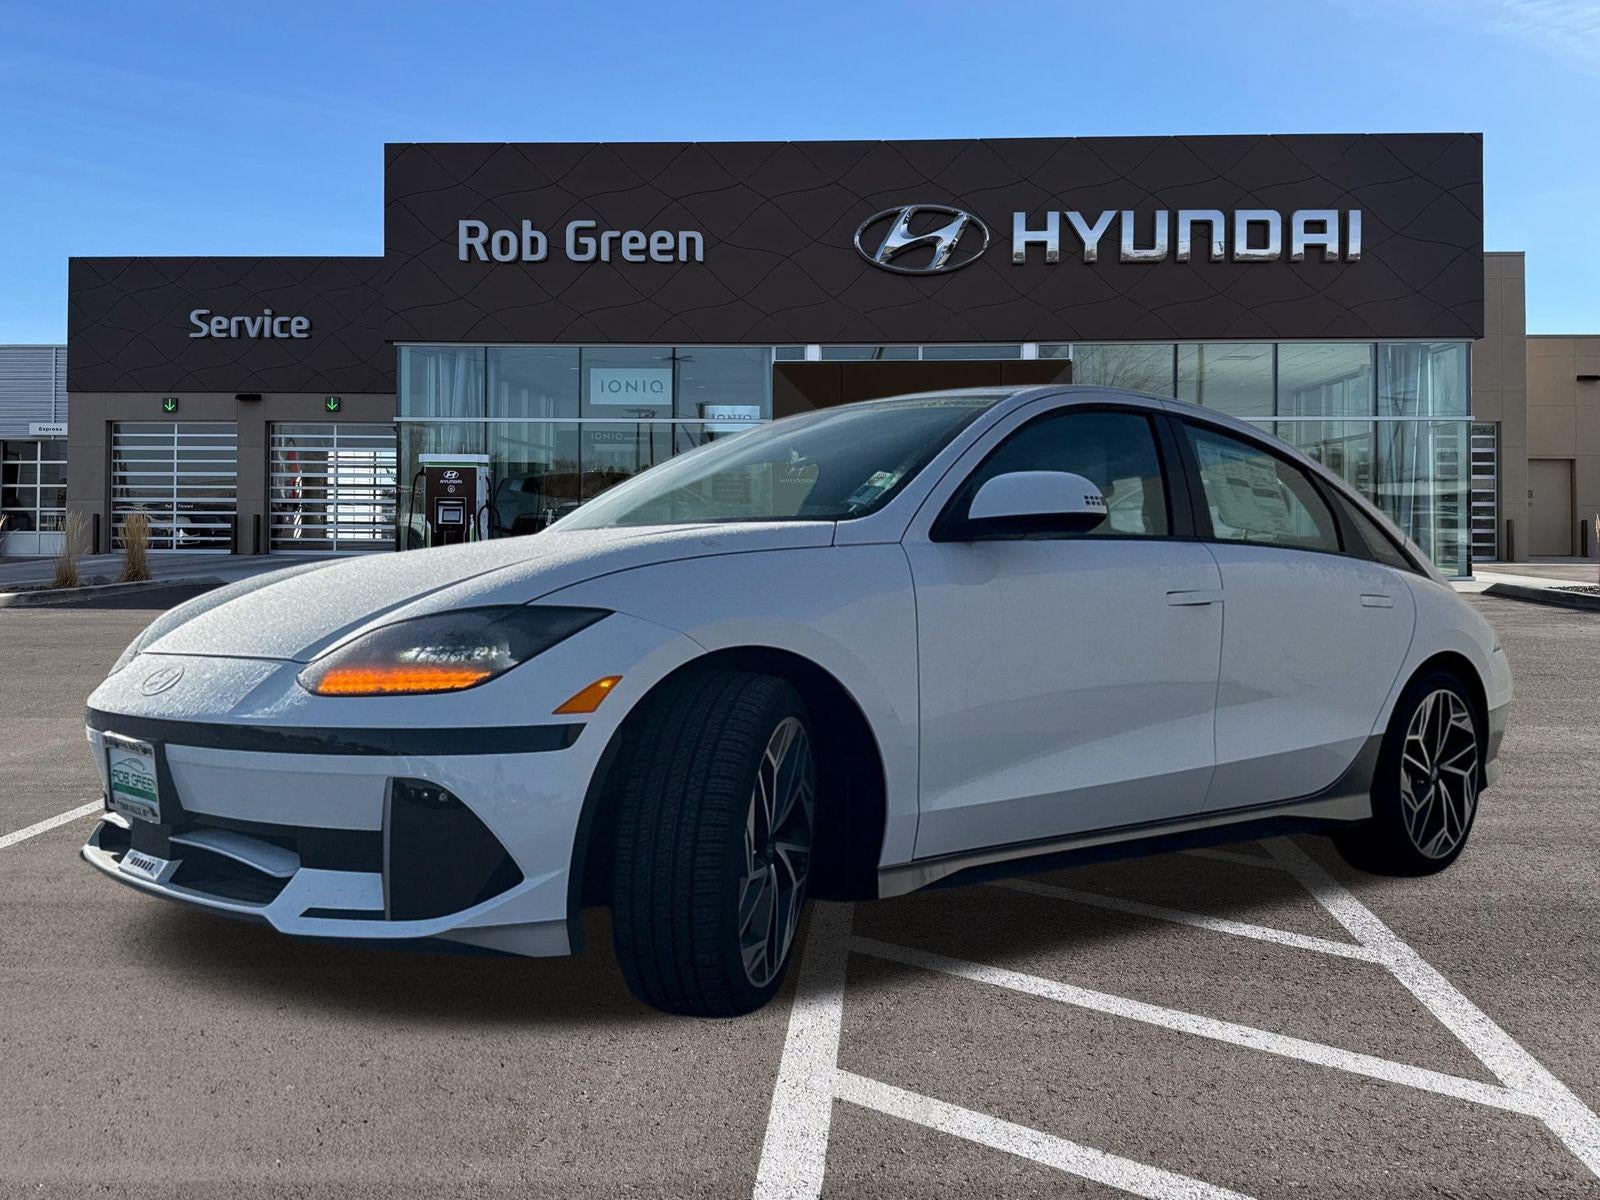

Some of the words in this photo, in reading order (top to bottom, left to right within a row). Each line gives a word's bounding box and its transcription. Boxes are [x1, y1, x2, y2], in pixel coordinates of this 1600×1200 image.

[458, 219, 548, 262] Rob
[565, 219, 704, 262] Green
[1011, 208, 1363, 265] HYUNDAI
[189, 308, 311, 339] Service
[600, 379, 664, 394] IONIQ
[590, 432, 623, 441] IONIQ
